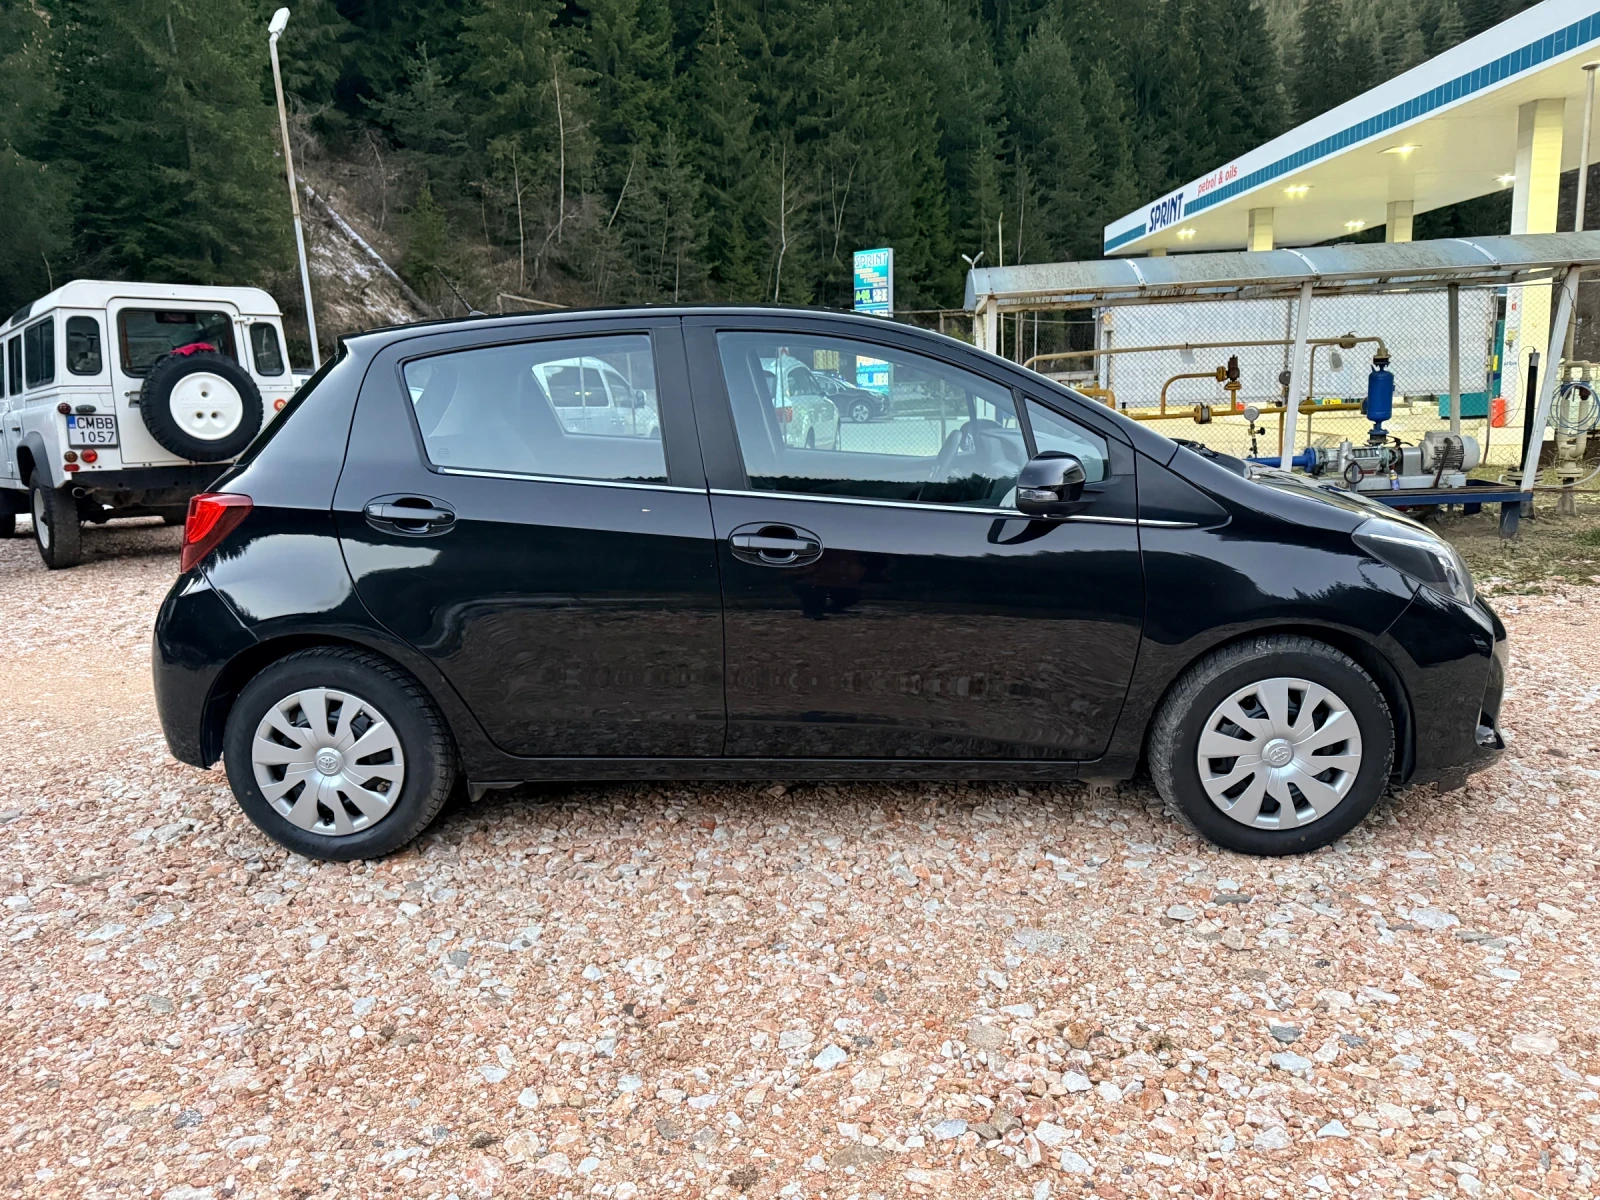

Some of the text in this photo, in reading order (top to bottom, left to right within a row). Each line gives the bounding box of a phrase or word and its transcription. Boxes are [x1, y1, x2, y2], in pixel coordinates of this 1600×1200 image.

[1197, 165, 1238, 197] petrol & oils
[1149, 192, 1184, 232] SPRINT
[855, 252, 887, 268] SPRINT
[76, 417, 114, 429] CMBB
[80, 431, 114, 443] 1057
